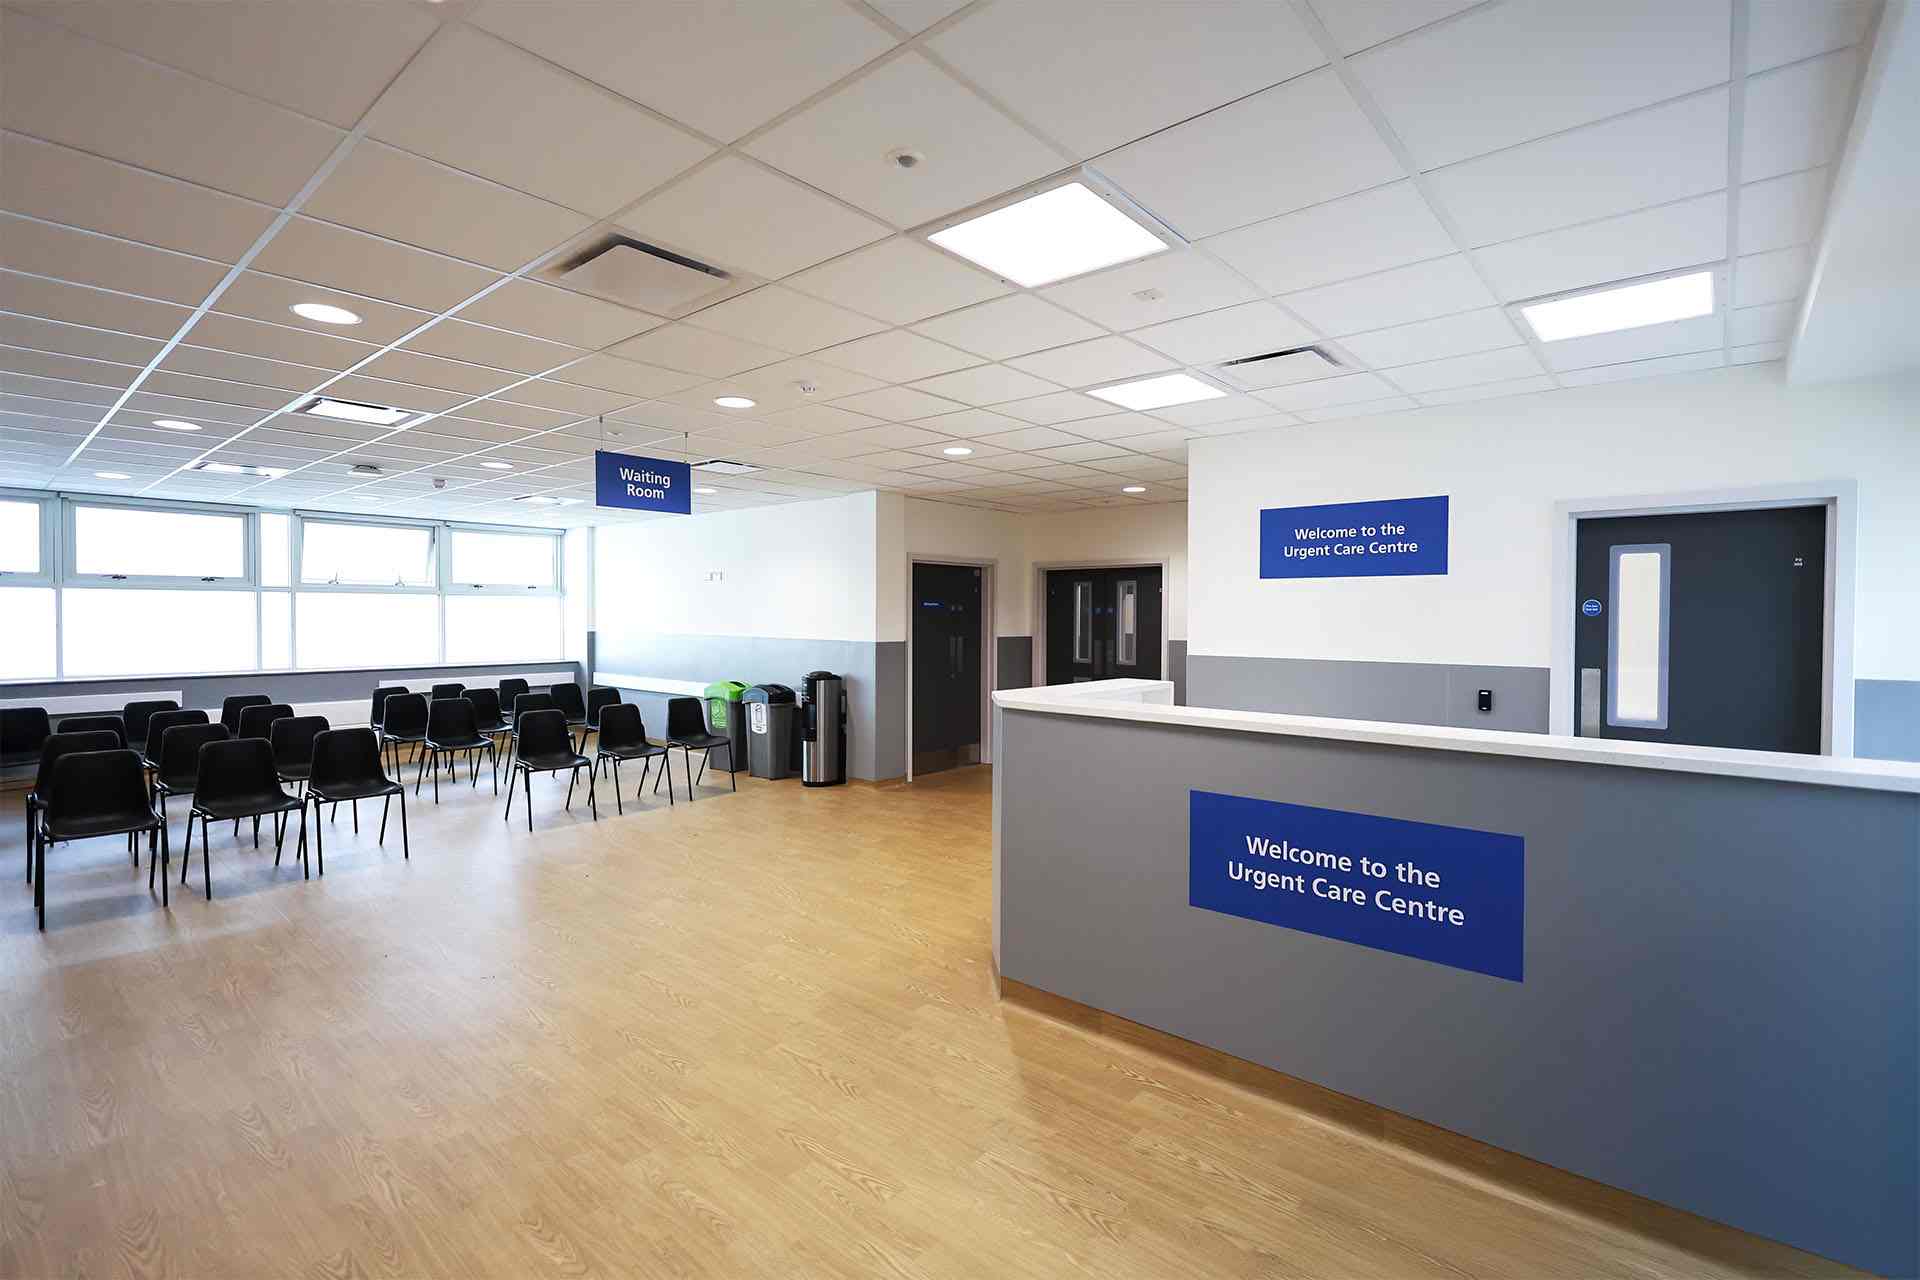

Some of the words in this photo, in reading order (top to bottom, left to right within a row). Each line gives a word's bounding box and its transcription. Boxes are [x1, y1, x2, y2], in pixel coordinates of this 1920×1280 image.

[619, 467, 671, 488] Waiting
[627, 483, 664, 499] Room
[1295, 527, 1357, 540] Welcome
[1361, 525, 1376, 537] to
[1380, 523, 1405, 536] the
[1284, 544, 1330, 560] Urgent
[1333, 543, 1365, 556] Care
[1369, 541, 1418, 554] Centre
[1246, 835, 1352, 872] Welcome
[1359, 856, 1387, 879] to
[1395, 861, 1441, 889] the
[1228, 860, 1305, 893] Urgent
[1311, 877, 1367, 906] Care
[1374, 890, 1465, 926] Centre
